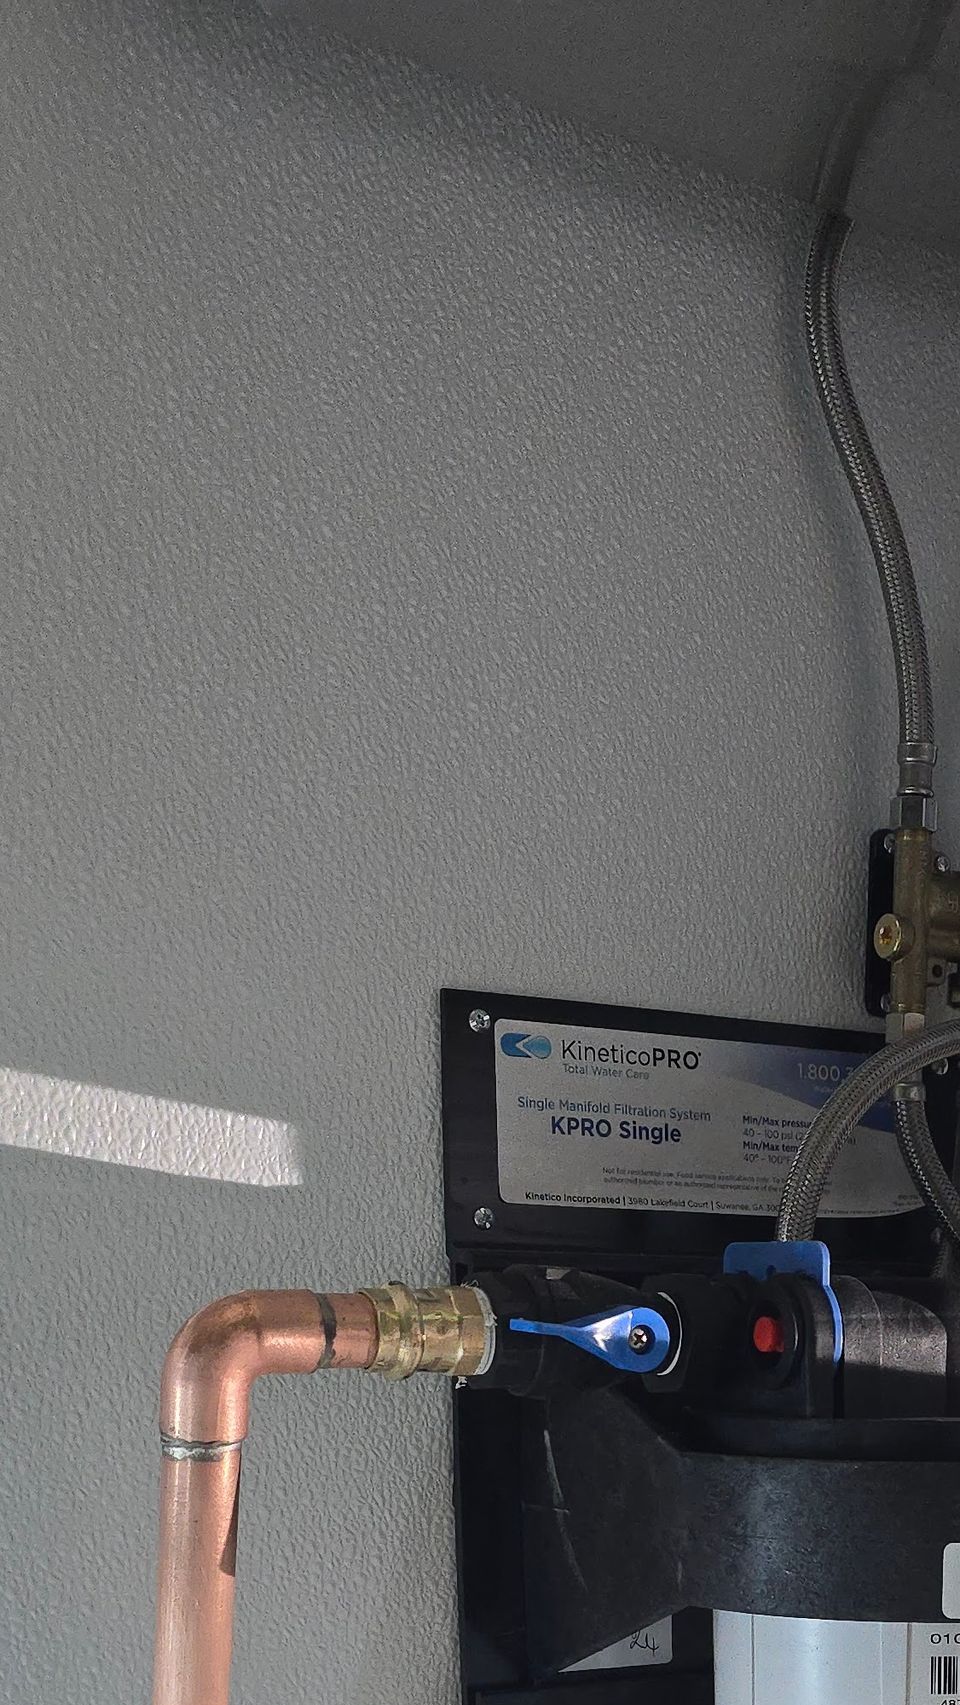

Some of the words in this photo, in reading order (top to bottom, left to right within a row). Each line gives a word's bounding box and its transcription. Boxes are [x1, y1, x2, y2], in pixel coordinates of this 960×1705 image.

[562, 1040, 699, 1070] KineticoPRO
[563, 1063, 588, 1075] Total
[591, 1066, 621, 1078] Water
[626, 1069, 650, 1080] Care
[518, 1096, 555, 1111] Single
[559, 1100, 610, 1114] Manifold
[615, 1104, 666, 1118] Filtration
[670, 1108, 711, 1122] System
[551, 1116, 611, 1137] KPRO
[619, 1121, 682, 1145] Single
[525, 1192, 562, 1202] Kinetico
[563, 1194, 621, 1205] Incorporated
